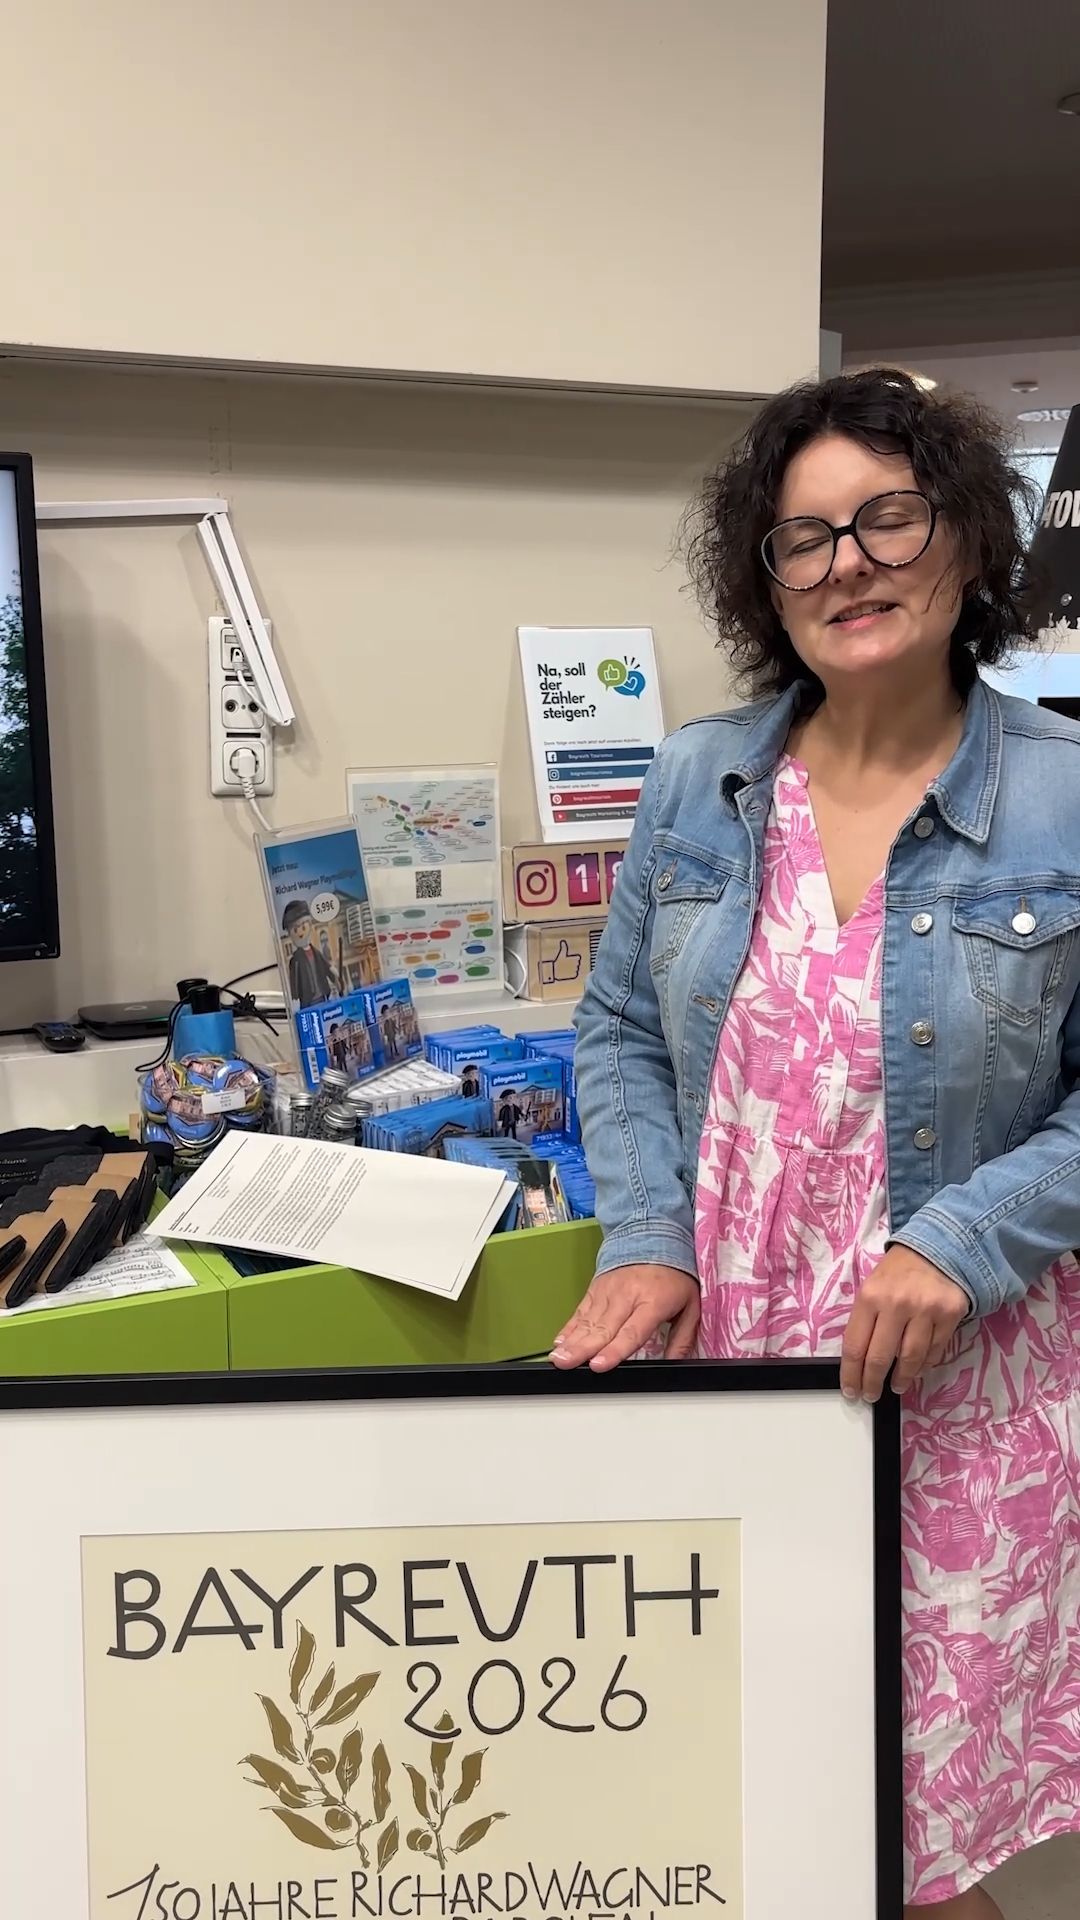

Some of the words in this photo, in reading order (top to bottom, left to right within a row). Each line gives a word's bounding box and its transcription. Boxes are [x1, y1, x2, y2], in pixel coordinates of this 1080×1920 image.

[537, 663, 562, 679] Na,
[564, 662, 586, 676] soll
[540, 677, 562, 691] der
[541, 690, 585, 705] Zähler
[543, 704, 597, 722] steigen?
[275, 882, 298, 896] Richard
[297, 878, 321, 891] Wagner
[315, 900, 335, 915] 5,99€
[456, 1050, 488, 1061] playmobil
[493, 1072, 527, 1086] playmobil
[106, 1552, 719, 1660] BAYREUTH
[404, 1654, 648, 1740] 2026
[106, 1863, 200, 1920] 150
[351, 1871, 528, 1917] RICHARD
[527, 1861, 726, 1911] WAGNER
